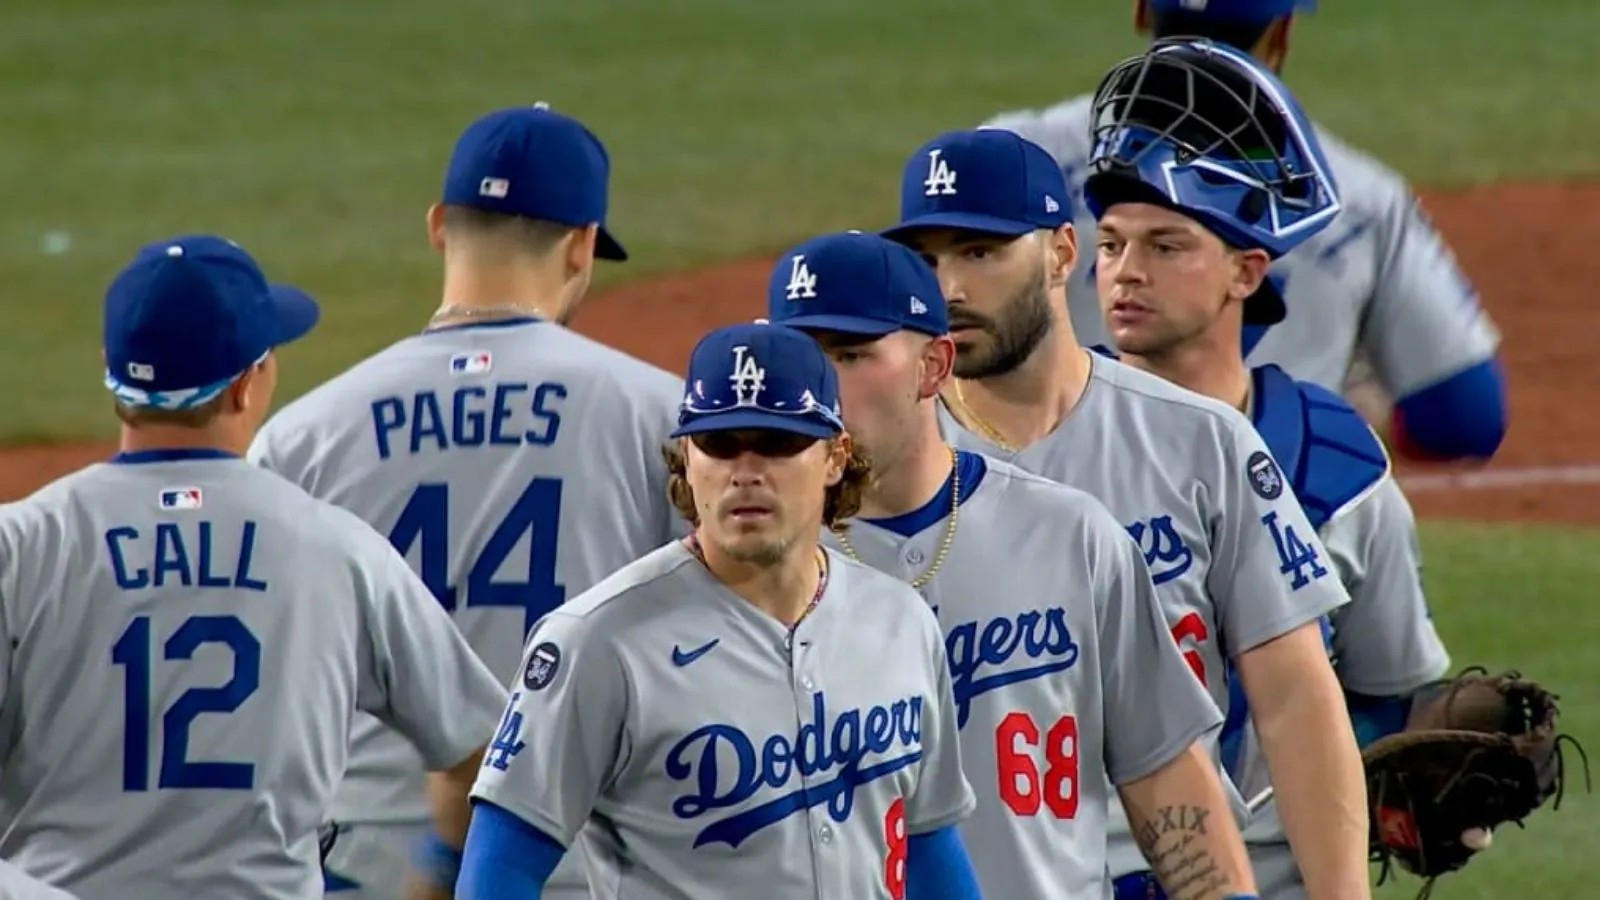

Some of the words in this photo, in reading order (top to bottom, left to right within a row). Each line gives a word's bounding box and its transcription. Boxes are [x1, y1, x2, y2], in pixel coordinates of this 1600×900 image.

[925, 148, 957, 196] LA
[786, 254, 817, 300] LA
[728, 345, 767, 391] LA
[371, 382, 567, 461] PAGES
[105, 520, 268, 592] CALL
[388, 475, 566, 647] 44
[1261, 510, 1328, 591] LA
[112, 615, 261, 792] 12
[935, 605, 1079, 732] gers
[995, 711, 1079, 820] 68
